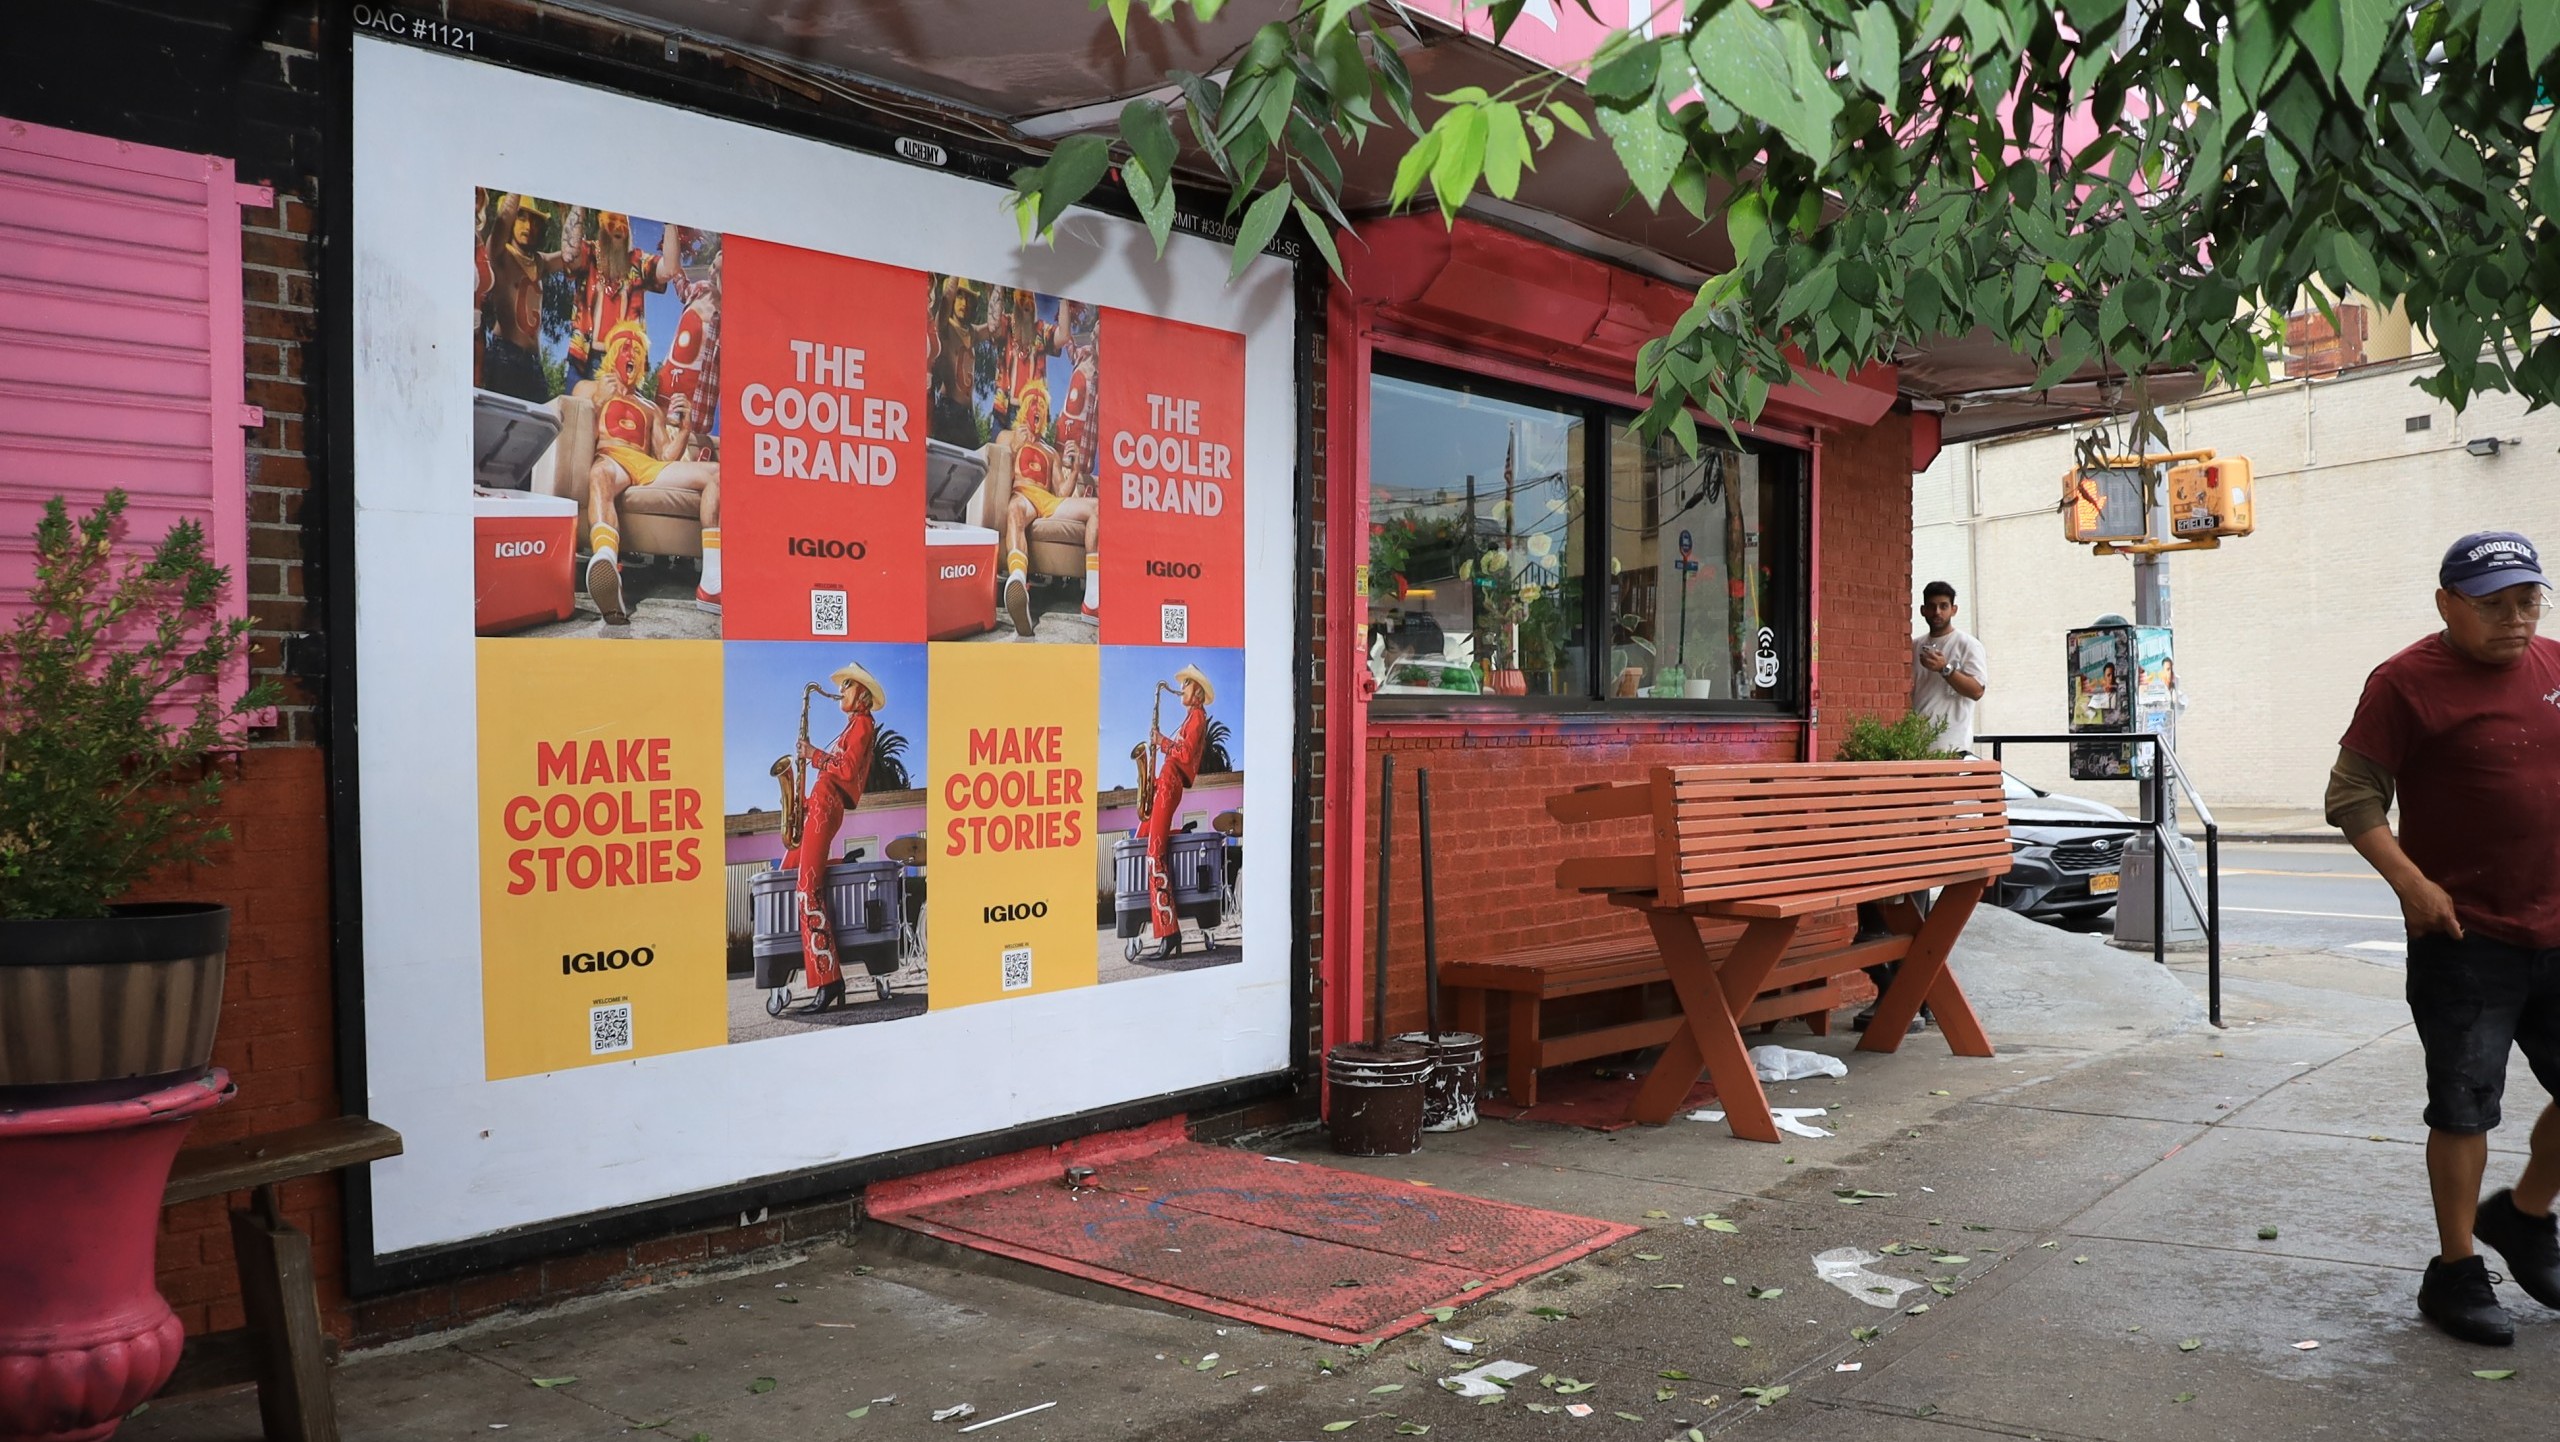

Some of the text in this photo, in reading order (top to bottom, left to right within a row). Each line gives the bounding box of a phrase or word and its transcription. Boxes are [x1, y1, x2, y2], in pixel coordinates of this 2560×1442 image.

[353, 4, 474, 51] OAC #1121
[1172, 210, 1200, 231] RMIT
[790, 339, 866, 390] THE
[740, 382, 910, 443] COOLER
[1146, 393, 1200, 436] THE
[753, 432, 898, 487] BRAND
[1112, 430, 1232, 479] COOLER
[1121, 472, 1223, 517] BRAND
[495, 539, 547, 559] IGLOO
[788, 536, 867, 560] IGLOO
[1146, 559, 1201, 579] IGLOO
[2468, 541, 2532, 561] BROOKLYN
[939, 563, 977, 580] IGLOO
[537, 738, 671, 787] MAKE
[969, 726, 1063, 766] MAKE
[944, 768, 1084, 812] COOLER
[503, 788, 704, 841] COOLER
[946, 810, 1082, 857] STORIES
[506, 837, 702, 896] STORIES
[984, 901, 1048, 924] IGLOO
[562, 946, 654, 975] IGLOO
[593, 996, 620, 1004] WELCOME
